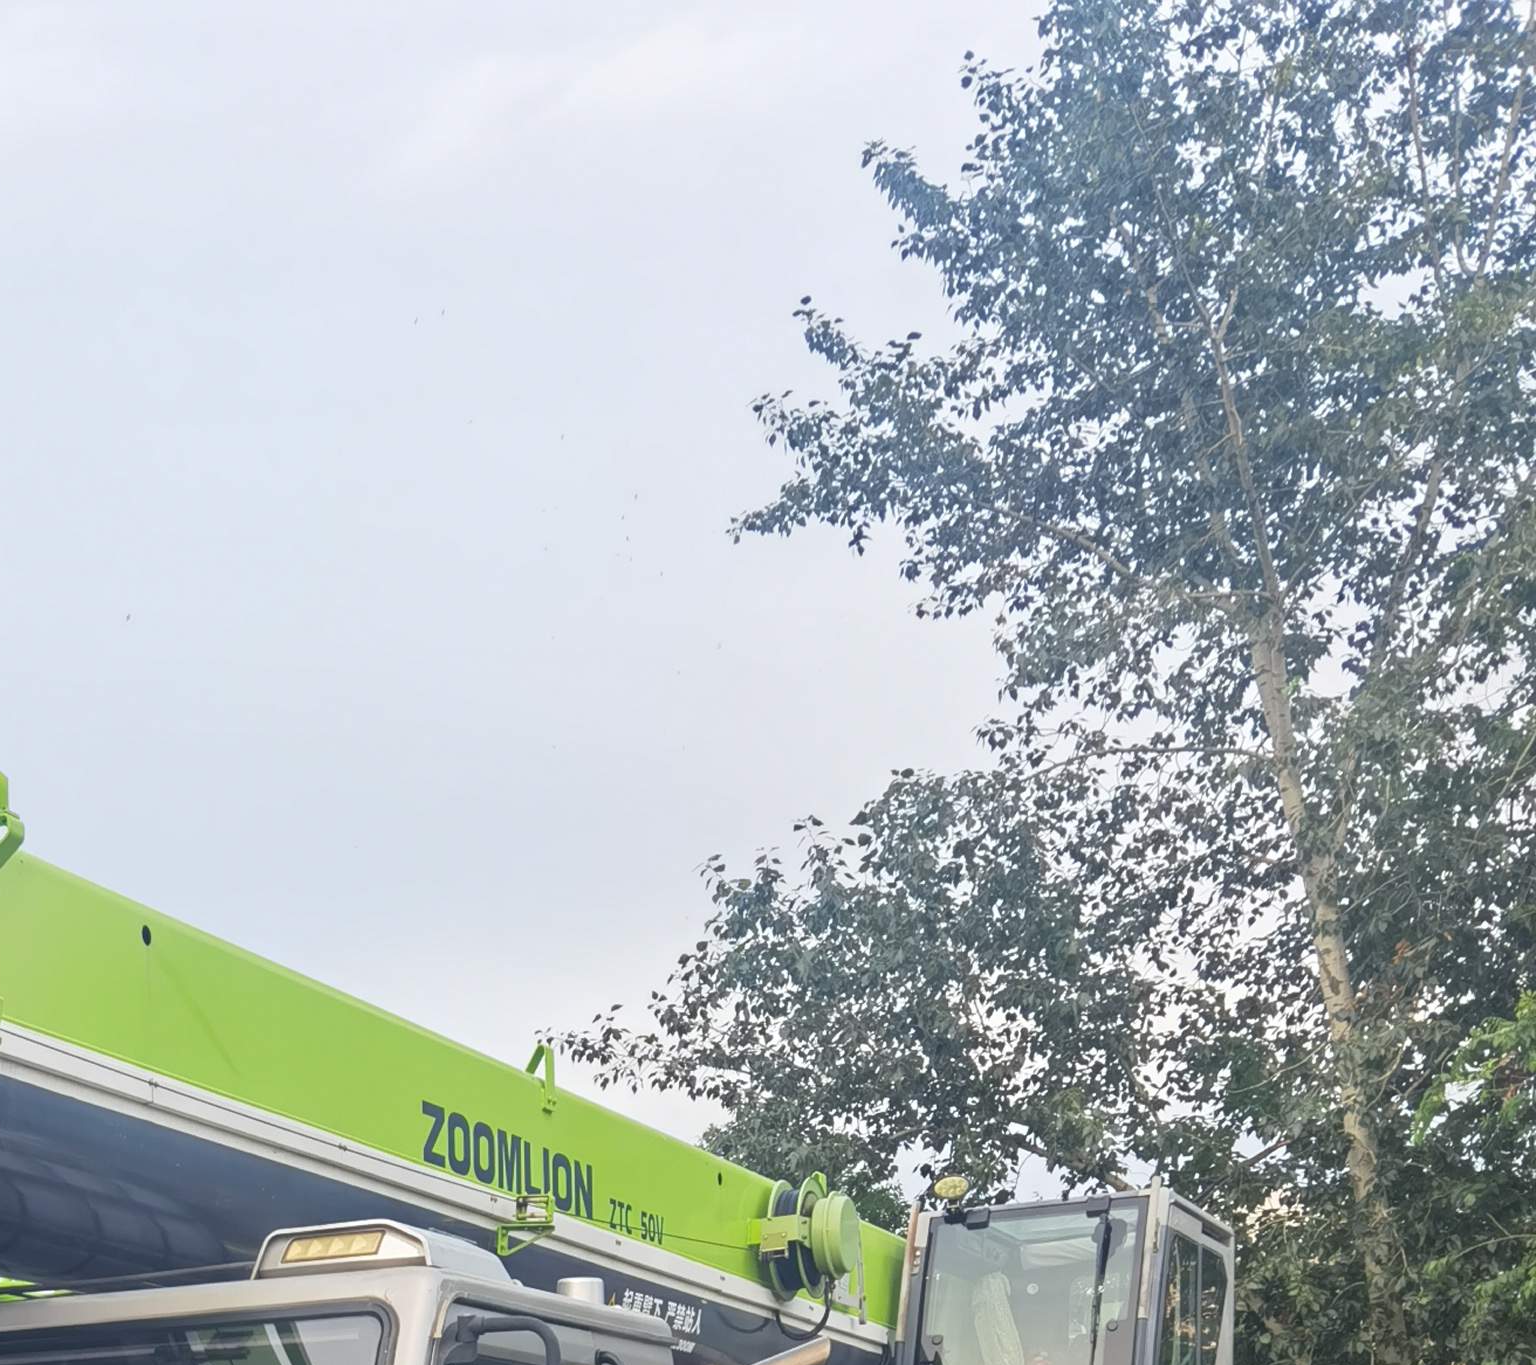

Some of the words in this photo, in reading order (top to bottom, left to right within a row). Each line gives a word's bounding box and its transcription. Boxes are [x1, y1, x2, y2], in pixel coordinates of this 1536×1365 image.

[421, 1099, 594, 1221] ZOOMLION
[609, 1198, 633, 1235] ZTC
[664, 1301, 703, 1335] 严禁站人
